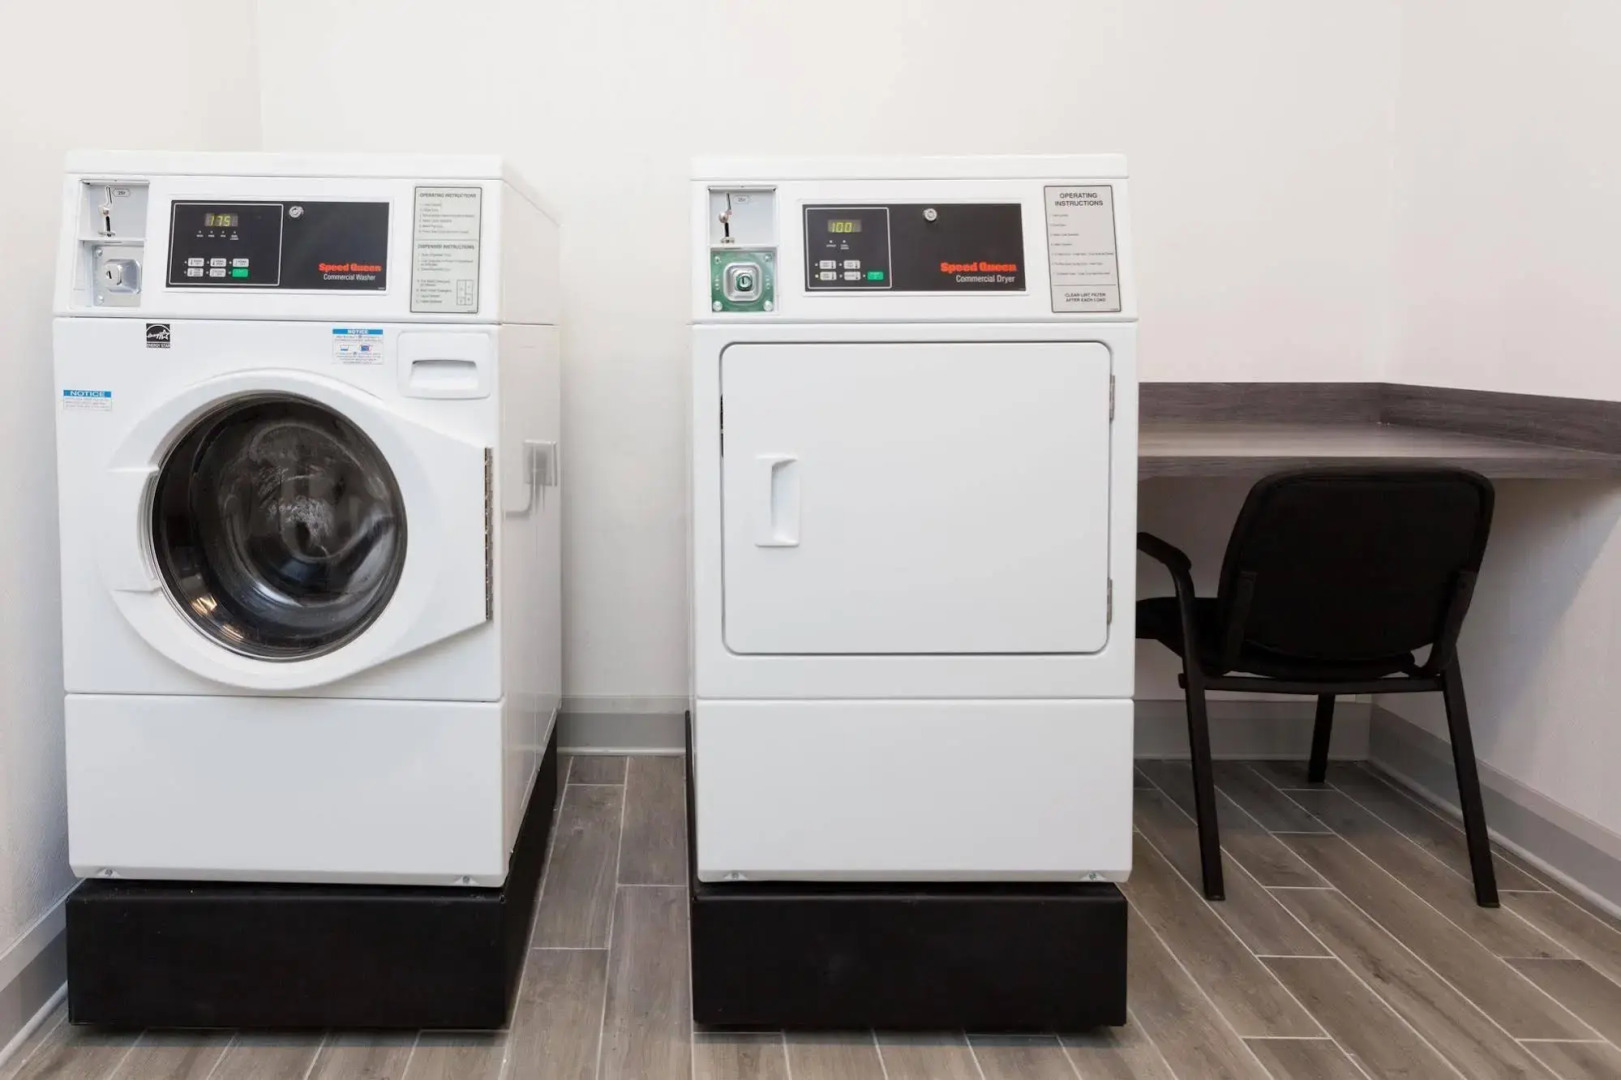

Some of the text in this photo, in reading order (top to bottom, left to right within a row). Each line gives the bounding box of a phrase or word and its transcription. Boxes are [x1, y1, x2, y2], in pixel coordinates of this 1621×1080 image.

[210, 215, 231, 227] 175
[831, 222, 853, 233] 100
[319, 263, 383, 273] Speed Queen
[940, 262, 1017, 274] Speed Queen
[323, 273, 355, 281] Commercial
[955, 274, 1016, 284] Commercial Dryer
[70, 390, 104, 398] NOTICE
